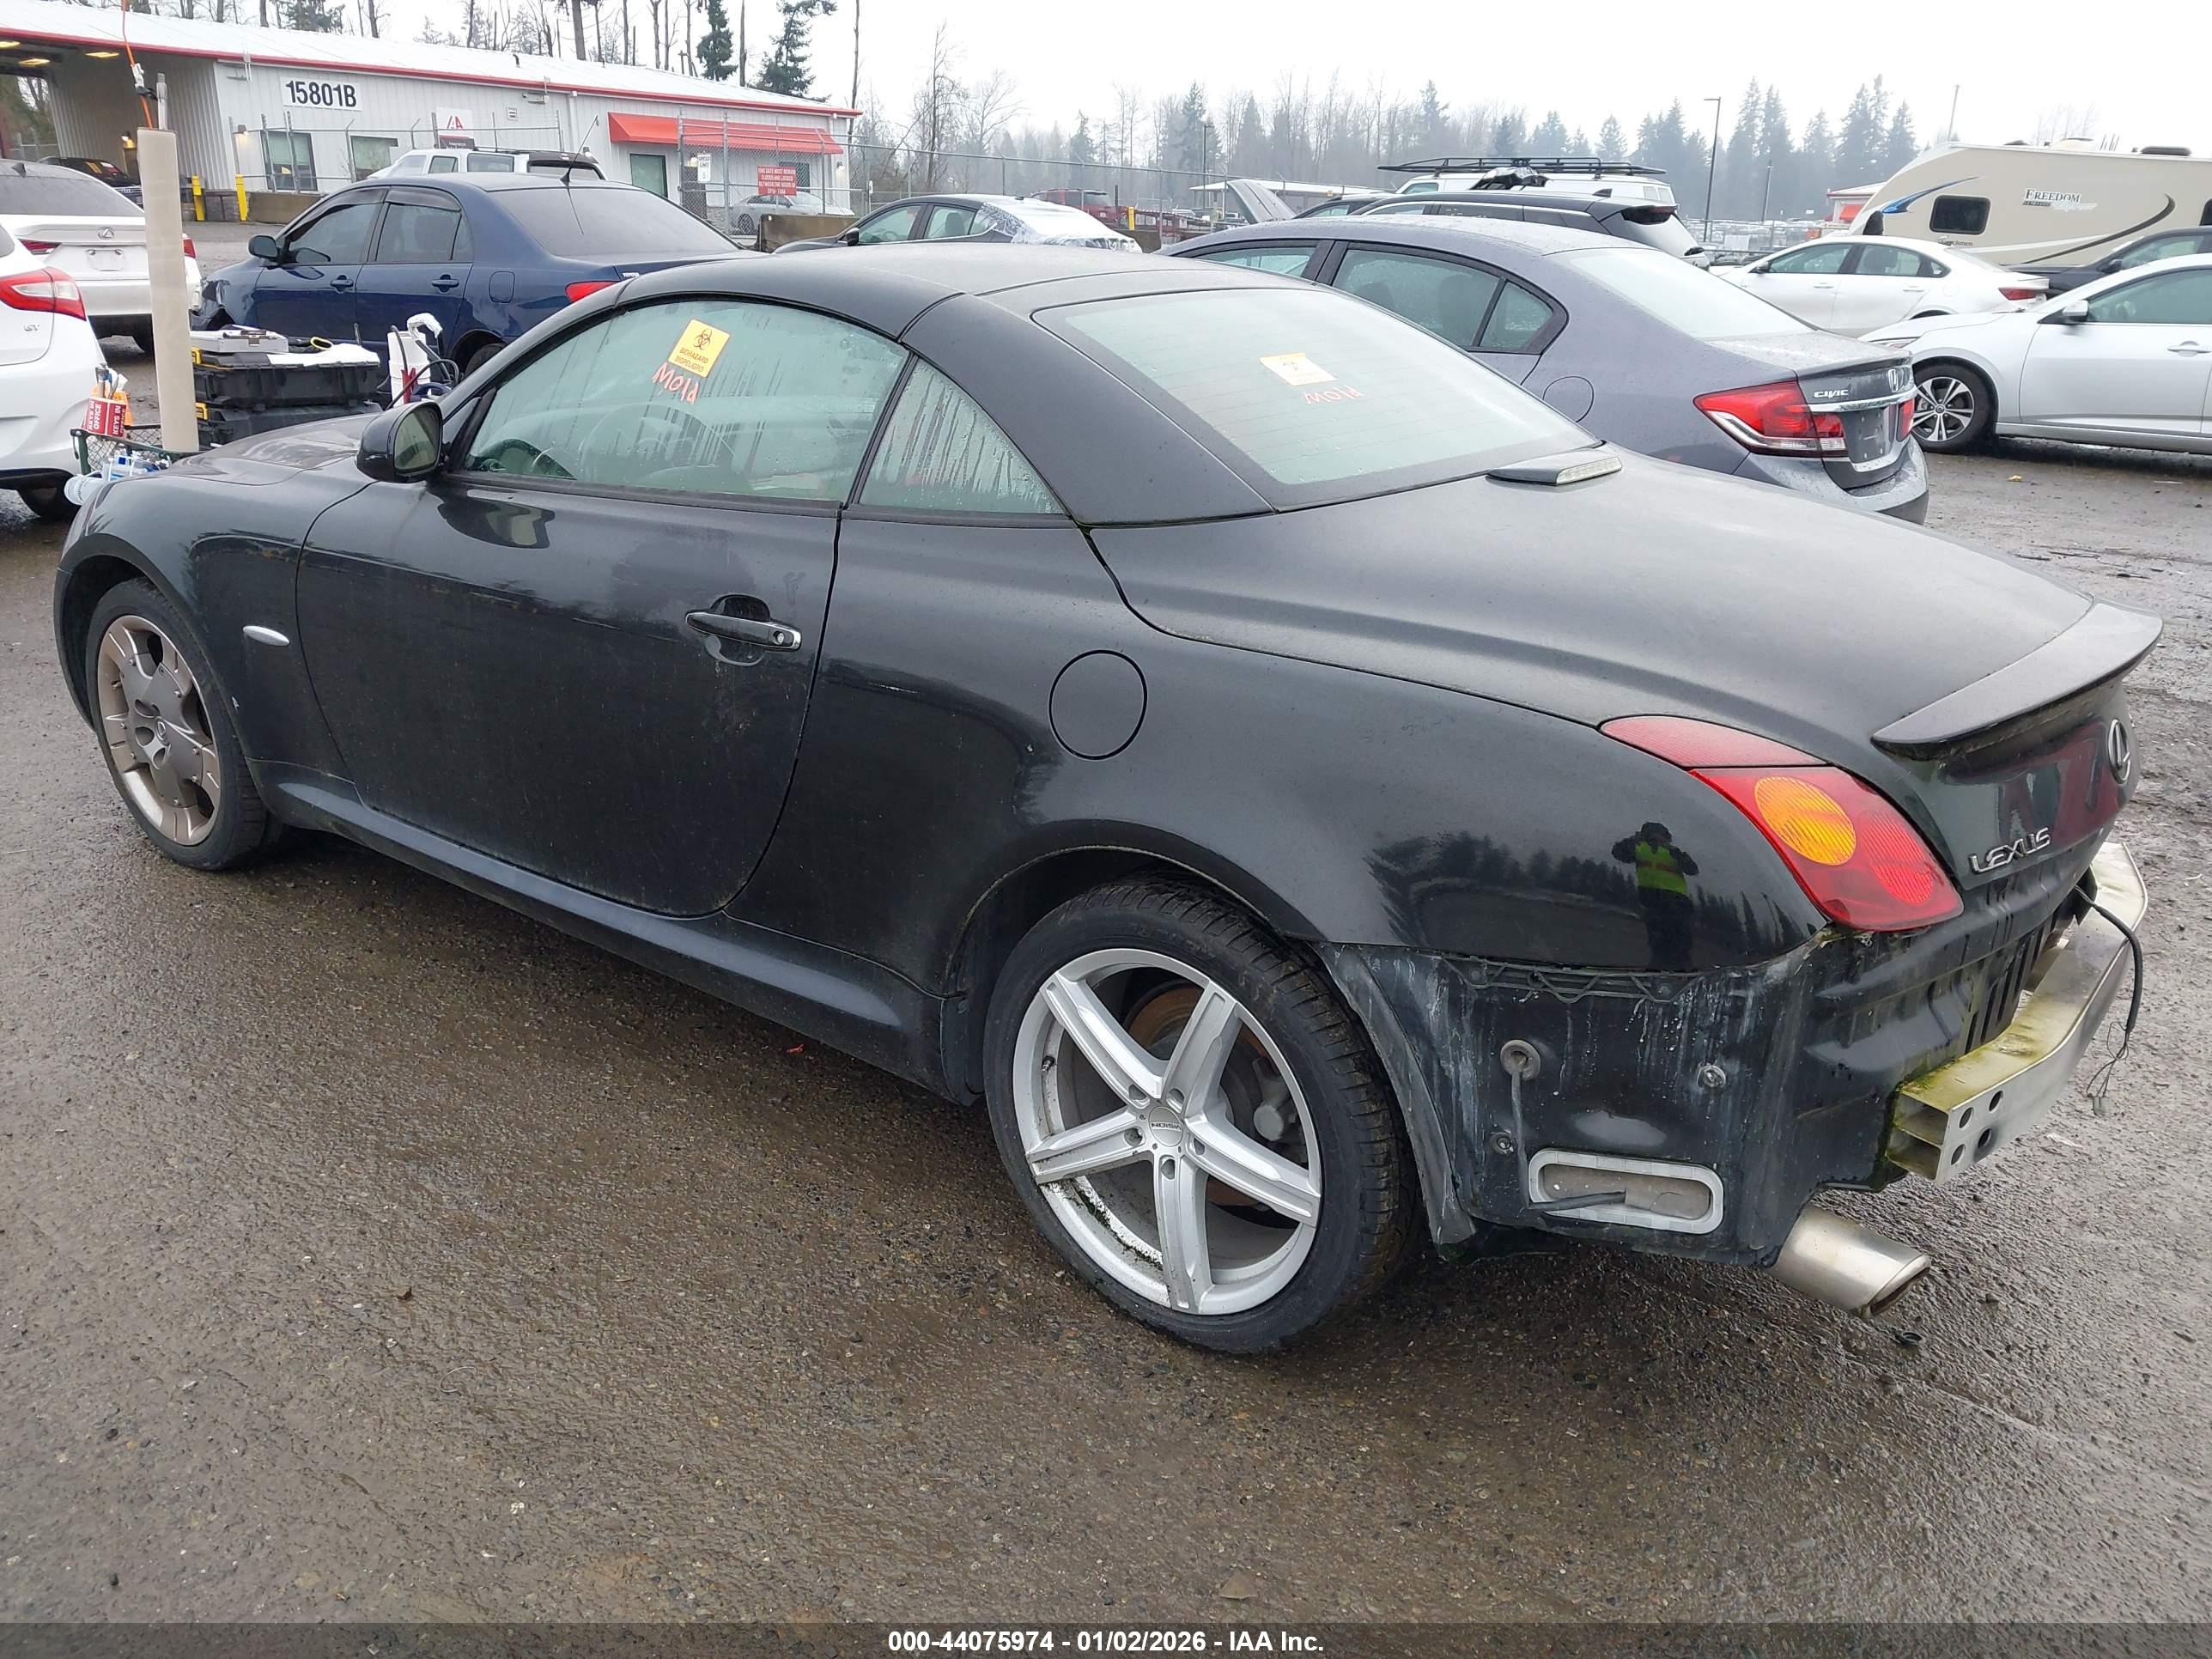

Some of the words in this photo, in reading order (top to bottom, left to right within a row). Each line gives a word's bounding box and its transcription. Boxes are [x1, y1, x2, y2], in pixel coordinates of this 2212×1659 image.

[285, 79, 357, 107] 15801B
[2025, 188, 2081, 204] FREEDOM
[674, 355, 704, 373] BIOPELIGRO
[679, 347, 709, 364] BIOHAZARD
[1814, 389, 1849, 398] CIVIC
[93, 403, 101, 430] OFFICE
[113, 404, 121, 414] IN
[1969, 827, 2051, 872] LEXUS
[1152, 1122, 1182, 1131] VISION
